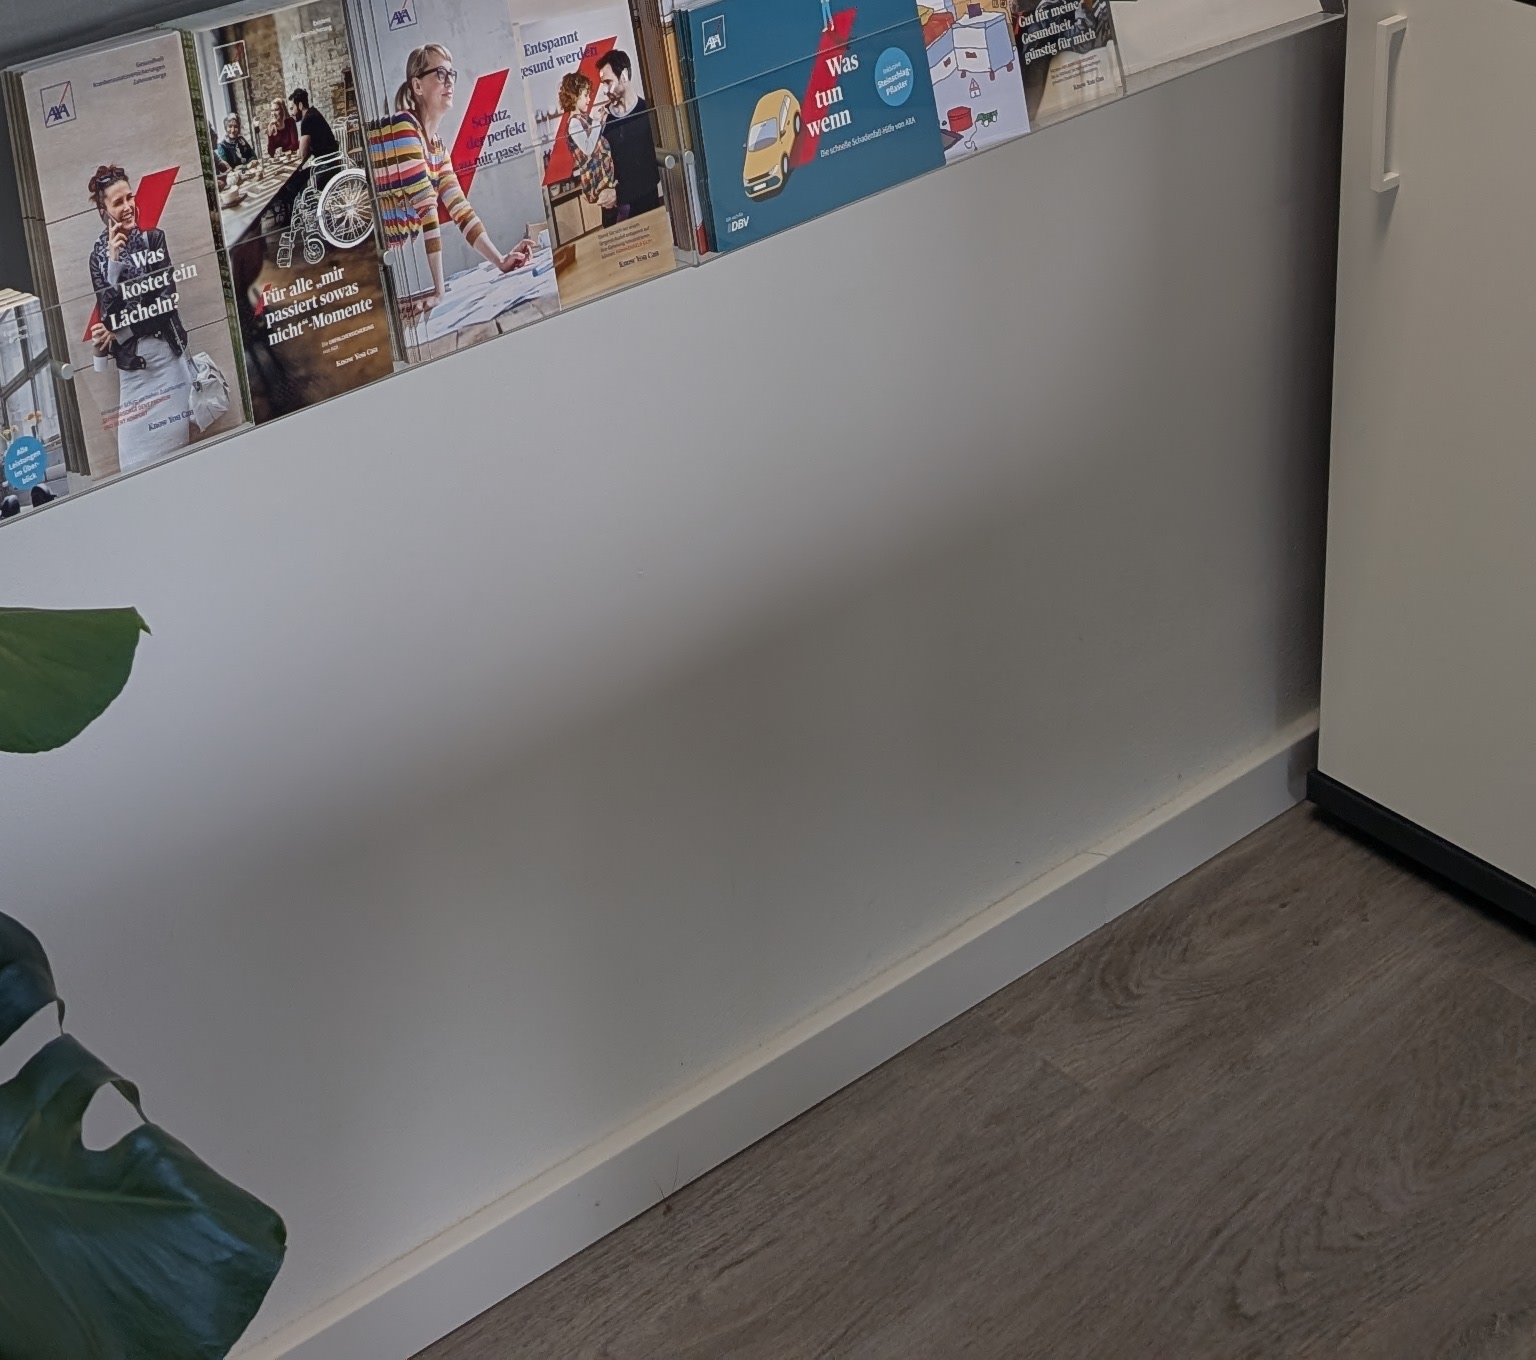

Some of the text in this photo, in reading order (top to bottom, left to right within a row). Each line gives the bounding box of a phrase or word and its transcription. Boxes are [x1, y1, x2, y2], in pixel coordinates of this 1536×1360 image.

[1018, 0, 1080, 28] Gut für meine
[523, 29, 580, 57] Entspannt
[1021, 18, 1075, 45] Gesundheit,
[555, 44, 598, 70] werden
[1024, 27, 1097, 66] günstig für mich
[825, 53, 859, 78] Was
[877, 67, 912, 90] Steinschlag-
[814, 85, 844, 109] tun
[472, 107, 512, 129] Schutz,
[806, 108, 853, 138] wenn
[467, 120, 526, 149] der perfekt
[820, 148, 830, 158] Die
[829, 140, 852, 155] schnelle
[894, 120, 905, 130] von
[905, 116, 917, 126] AXA
[474, 151, 494, 169] mir
[494, 141, 525, 165] passt
[731, 215, 750, 233] DBV
[130, 246, 165, 270] Was
[119, 260, 199, 303] kostet ein
[263, 265, 345, 307] Für alle „mir
[109, 291, 181, 333] Lächeln?
[264, 281, 360, 329] passiert sowas
[147, 408, 195, 432] Know You Can
[8, 449, 41, 471] Leistungen
[16, 445, 29, 457] Alle
[13, 460, 41, 478] im Über-
[21, 472, 37, 485] blick
